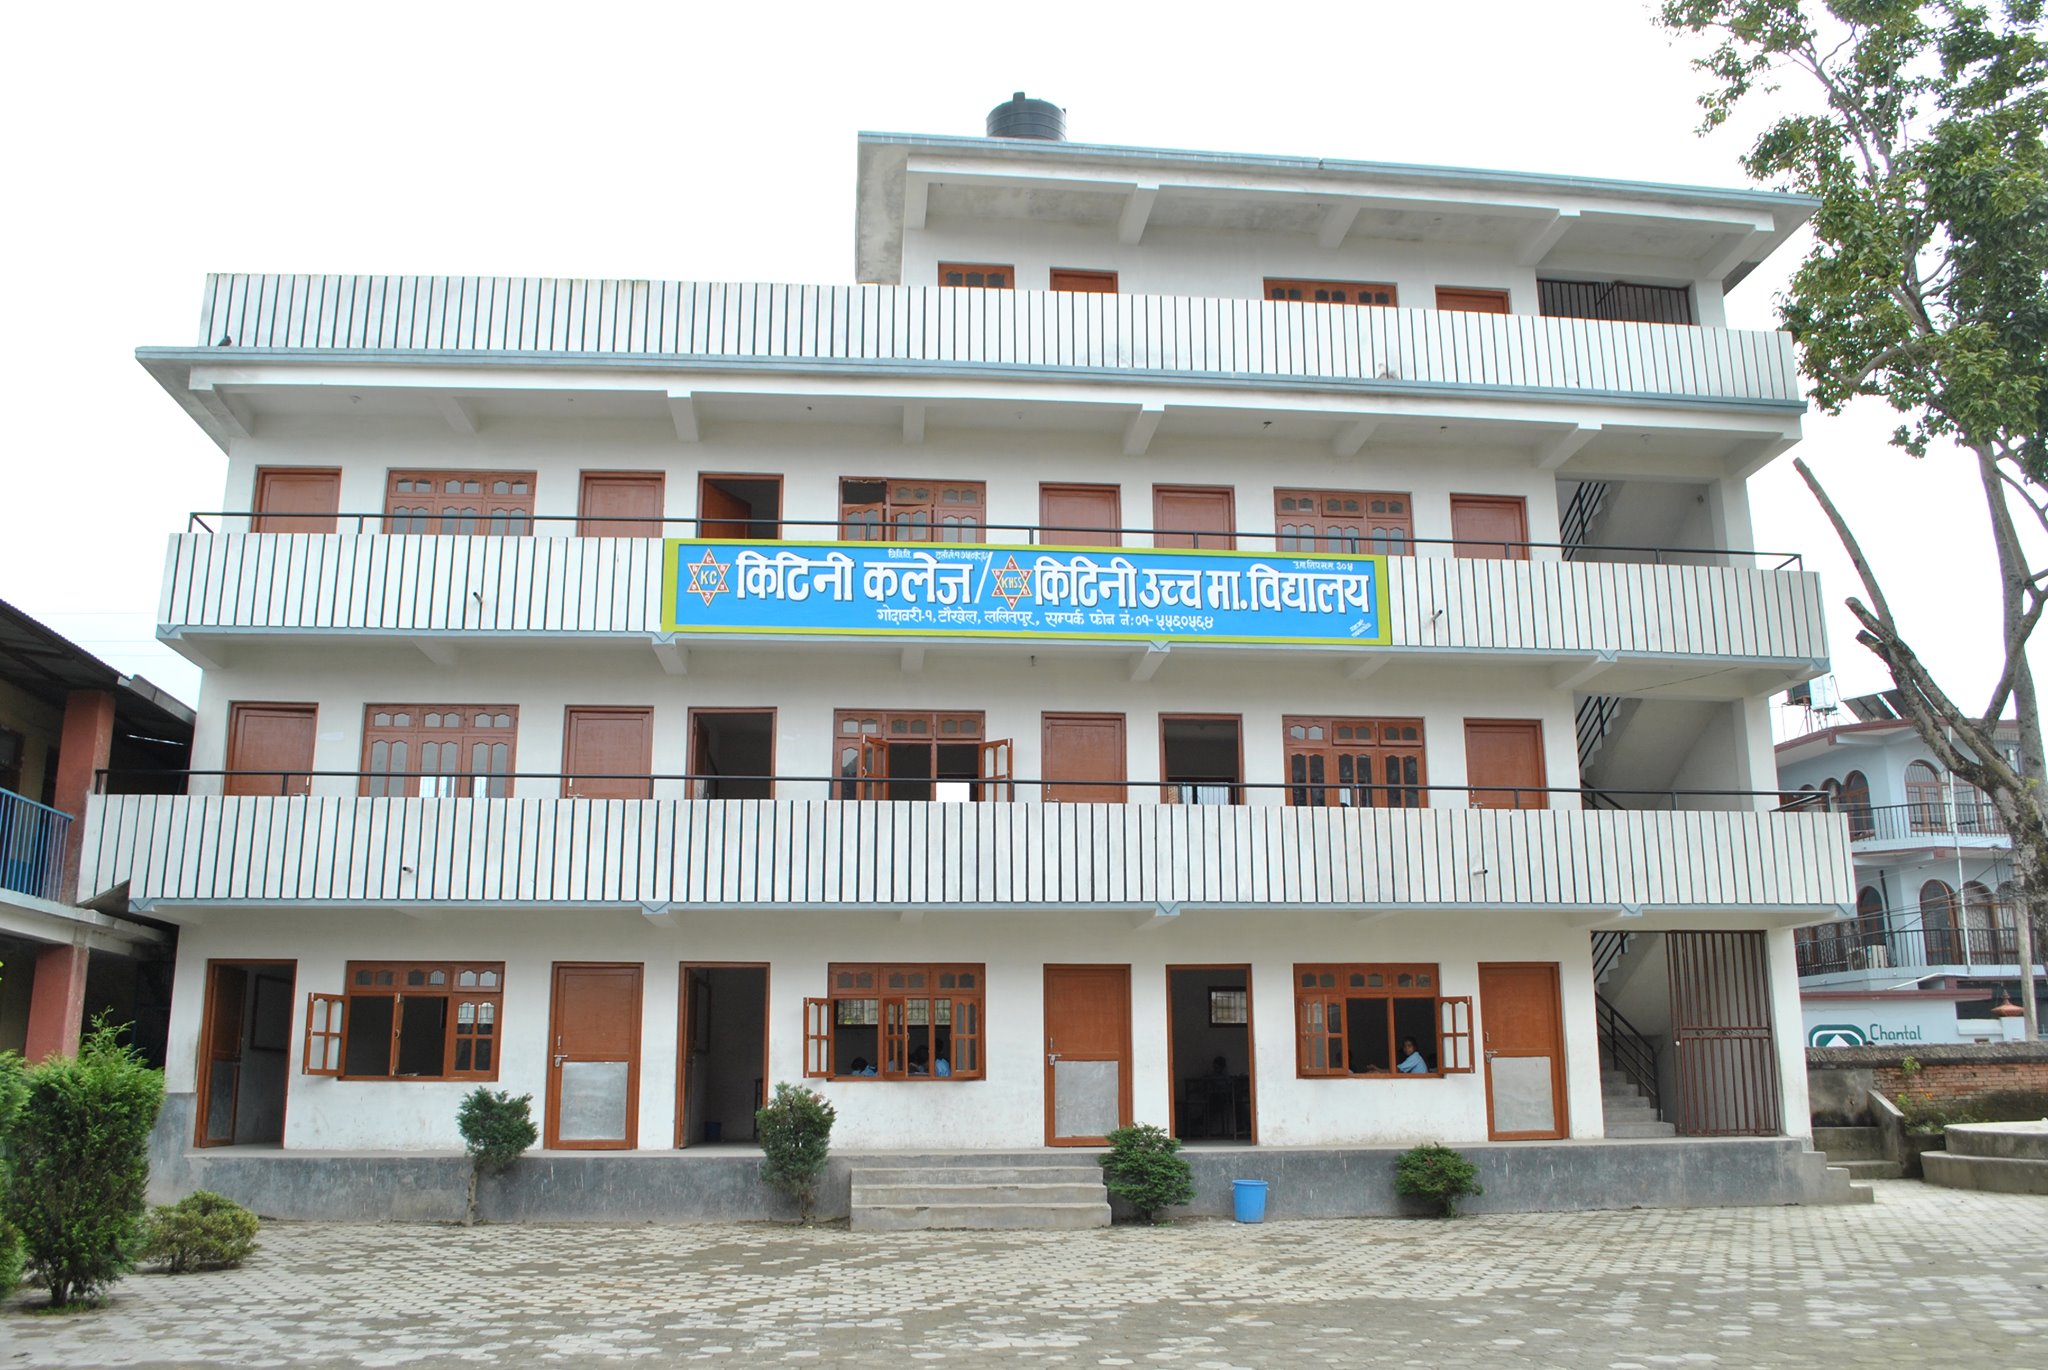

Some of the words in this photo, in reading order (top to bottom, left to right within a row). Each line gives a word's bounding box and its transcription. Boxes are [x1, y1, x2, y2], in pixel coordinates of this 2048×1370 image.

[700, 570, 718, 585] KC
[735, 550, 856, 602] किटिनी
[1001, 576, 1022, 589] KHSS
[1033, 555, 1138, 609] किटिनी
[1139, 568, 1203, 610] उच्च
[1044, 608, 1085, 628] सम्पर्क
[1088, 609, 1116, 627] फोन
[1869, 1023, 1922, 1041] Chantal
